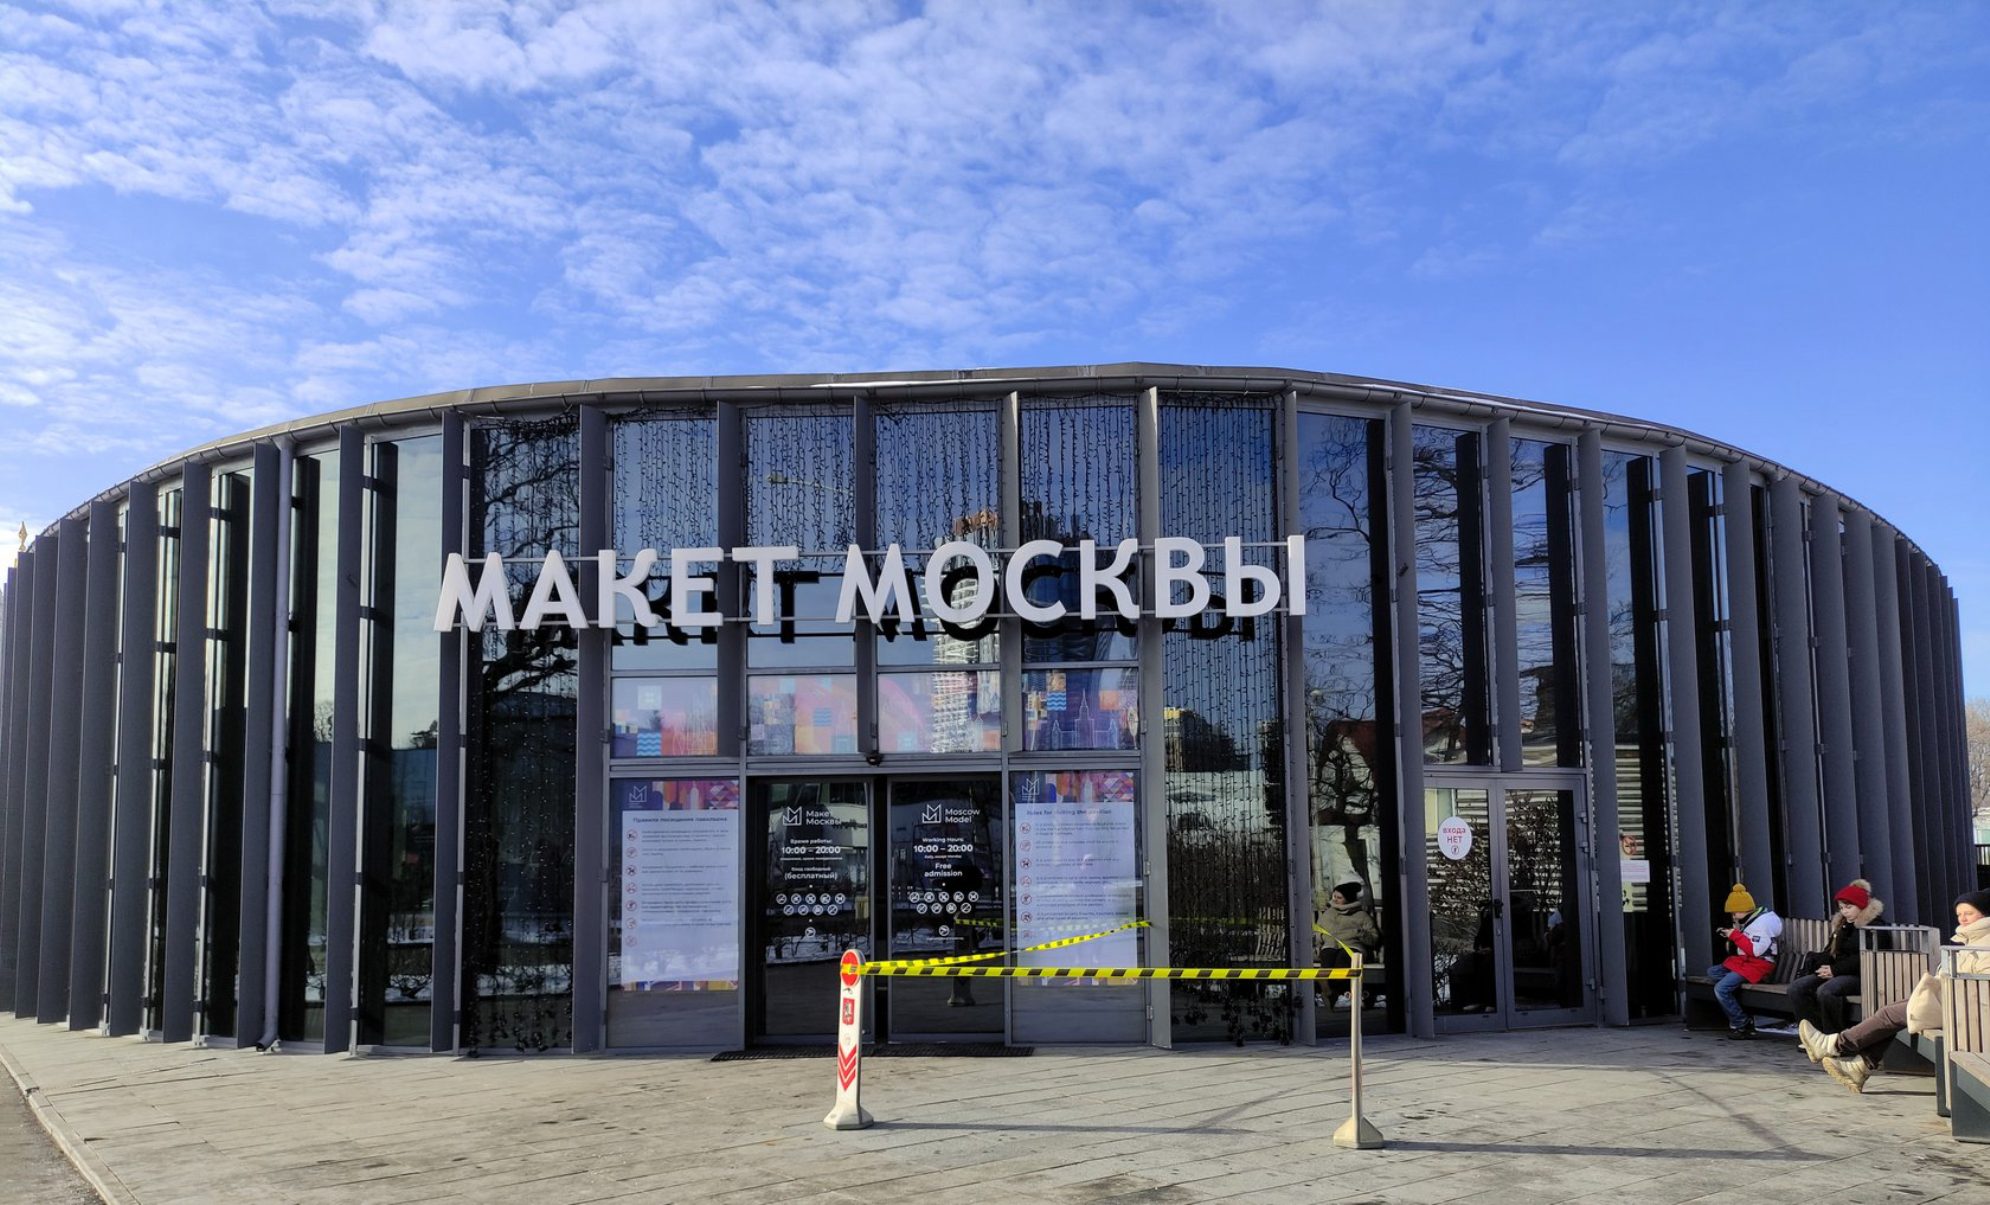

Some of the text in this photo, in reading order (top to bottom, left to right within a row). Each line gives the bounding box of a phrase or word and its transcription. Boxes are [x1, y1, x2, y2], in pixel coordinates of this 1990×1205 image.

[433, 534, 1306, 633] МАКЕТ МОСКВЫ
[944, 808, 980, 816] Moscow
[944, 815, 972, 823] Model
[781, 846, 807, 854] 10:00
[815, 845, 841, 854] 20:00
[912, 844, 939, 853] 10:00
[947, 844, 974, 852] 20:00
[784, 872, 838, 880] (бесплатный)
